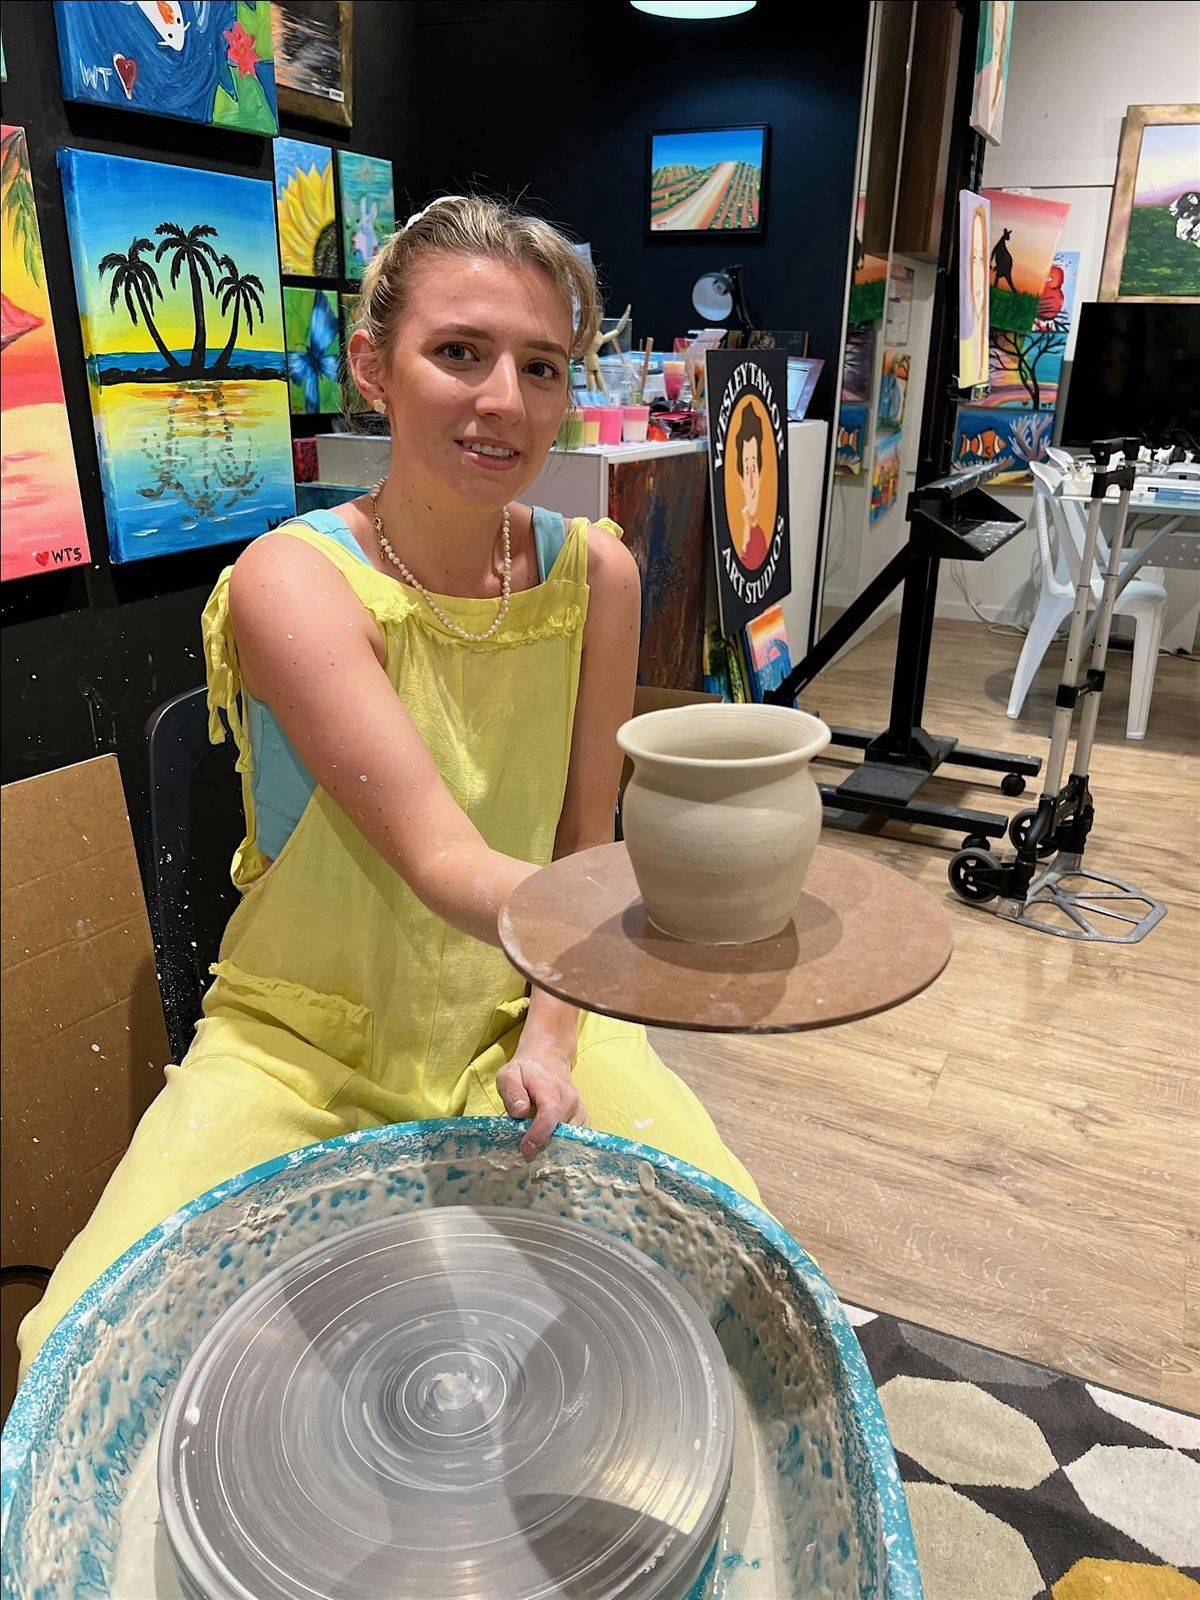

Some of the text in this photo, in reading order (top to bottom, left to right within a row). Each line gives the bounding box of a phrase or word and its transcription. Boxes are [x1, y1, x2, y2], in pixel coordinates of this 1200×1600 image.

[79, 57, 112, 92] WT
[714, 362, 784, 470] WESLEY TAYLOR
[51, 547, 82, 564] WTS
[722, 515, 784, 604] ART STUDIOS
